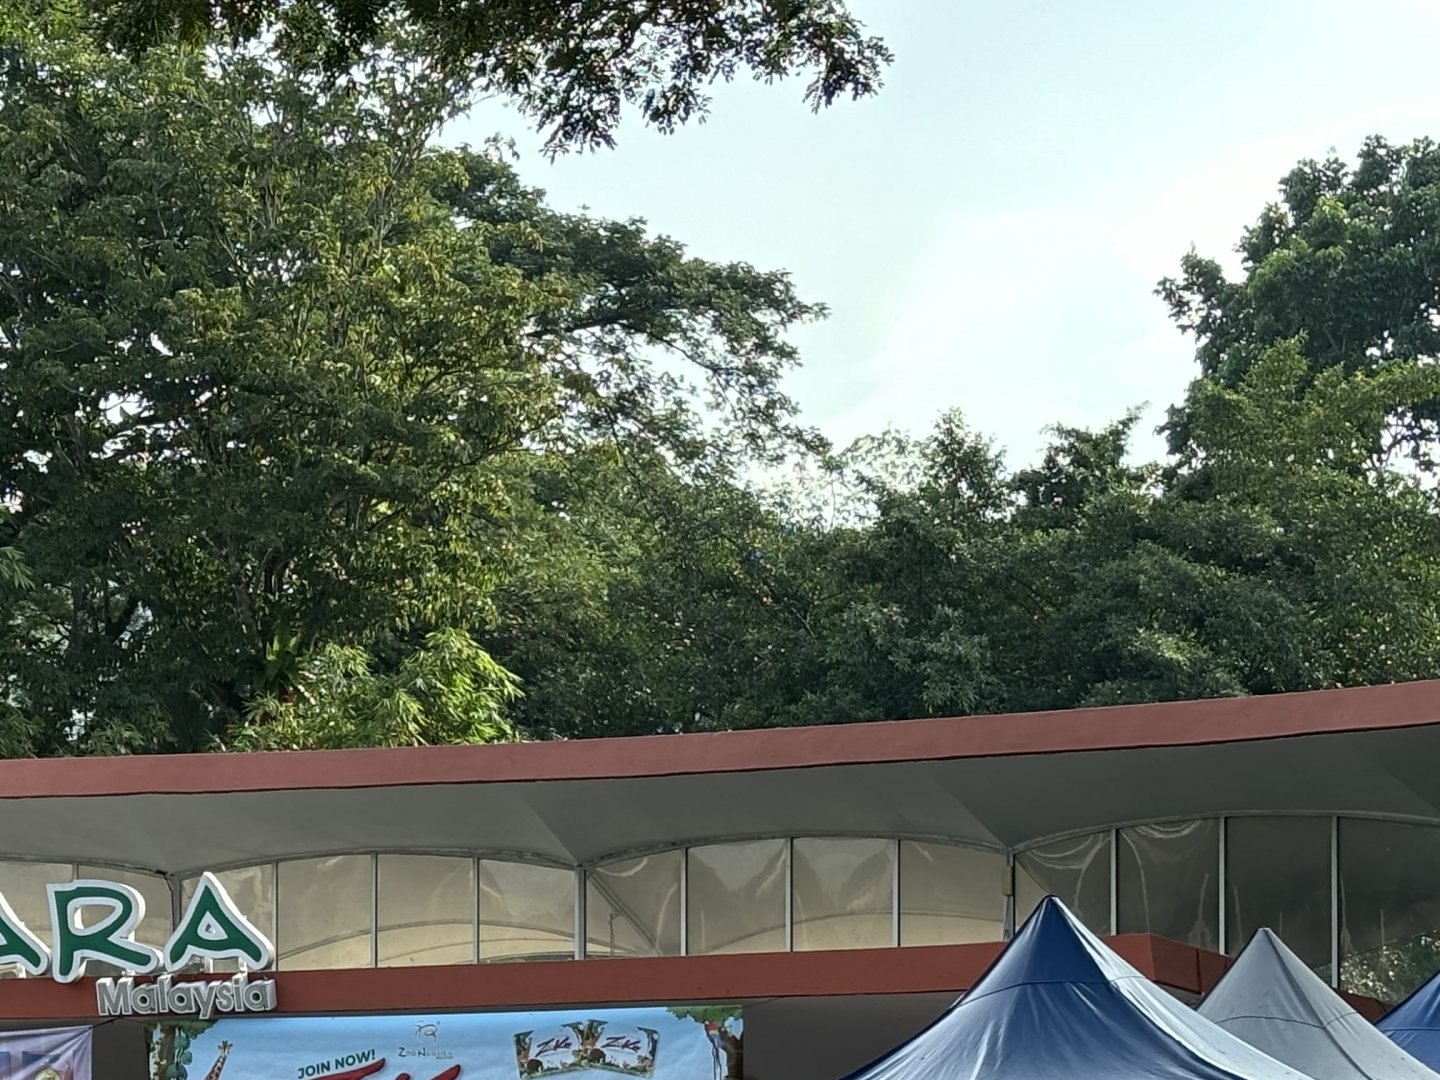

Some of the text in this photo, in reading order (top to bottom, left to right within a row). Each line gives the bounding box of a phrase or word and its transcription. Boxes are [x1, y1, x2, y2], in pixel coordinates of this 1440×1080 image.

[95, 975, 277, 1019] Malaysia
[297, 1049, 376, 1080] JOIN NOW!
